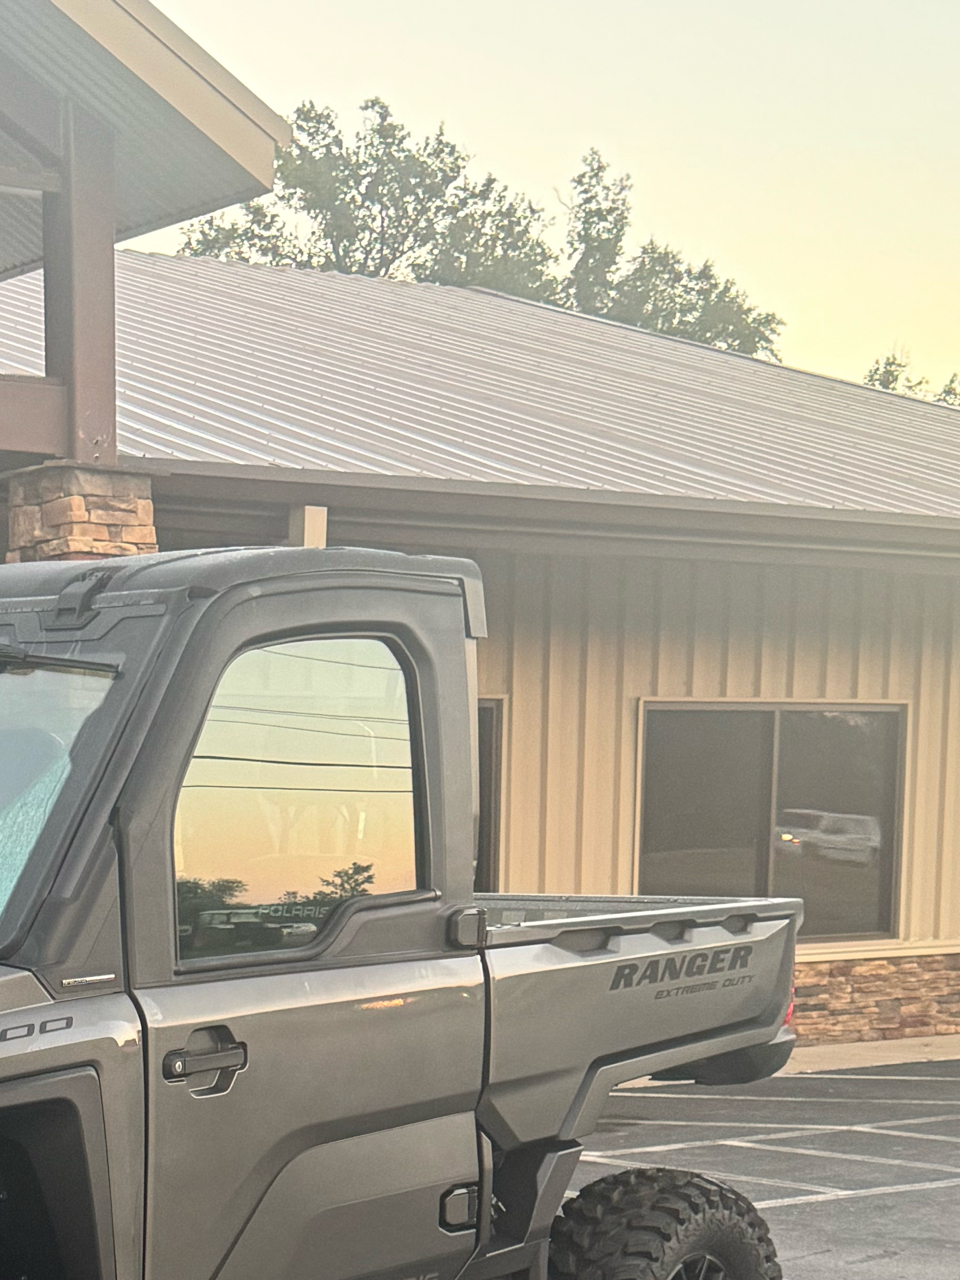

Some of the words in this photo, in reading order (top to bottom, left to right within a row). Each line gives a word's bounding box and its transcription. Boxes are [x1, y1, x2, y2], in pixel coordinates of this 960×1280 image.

[609, 945, 753, 991] RANGER
[654, 981, 718, 1000] EXTREME
[722, 974, 755, 988] DUTY
